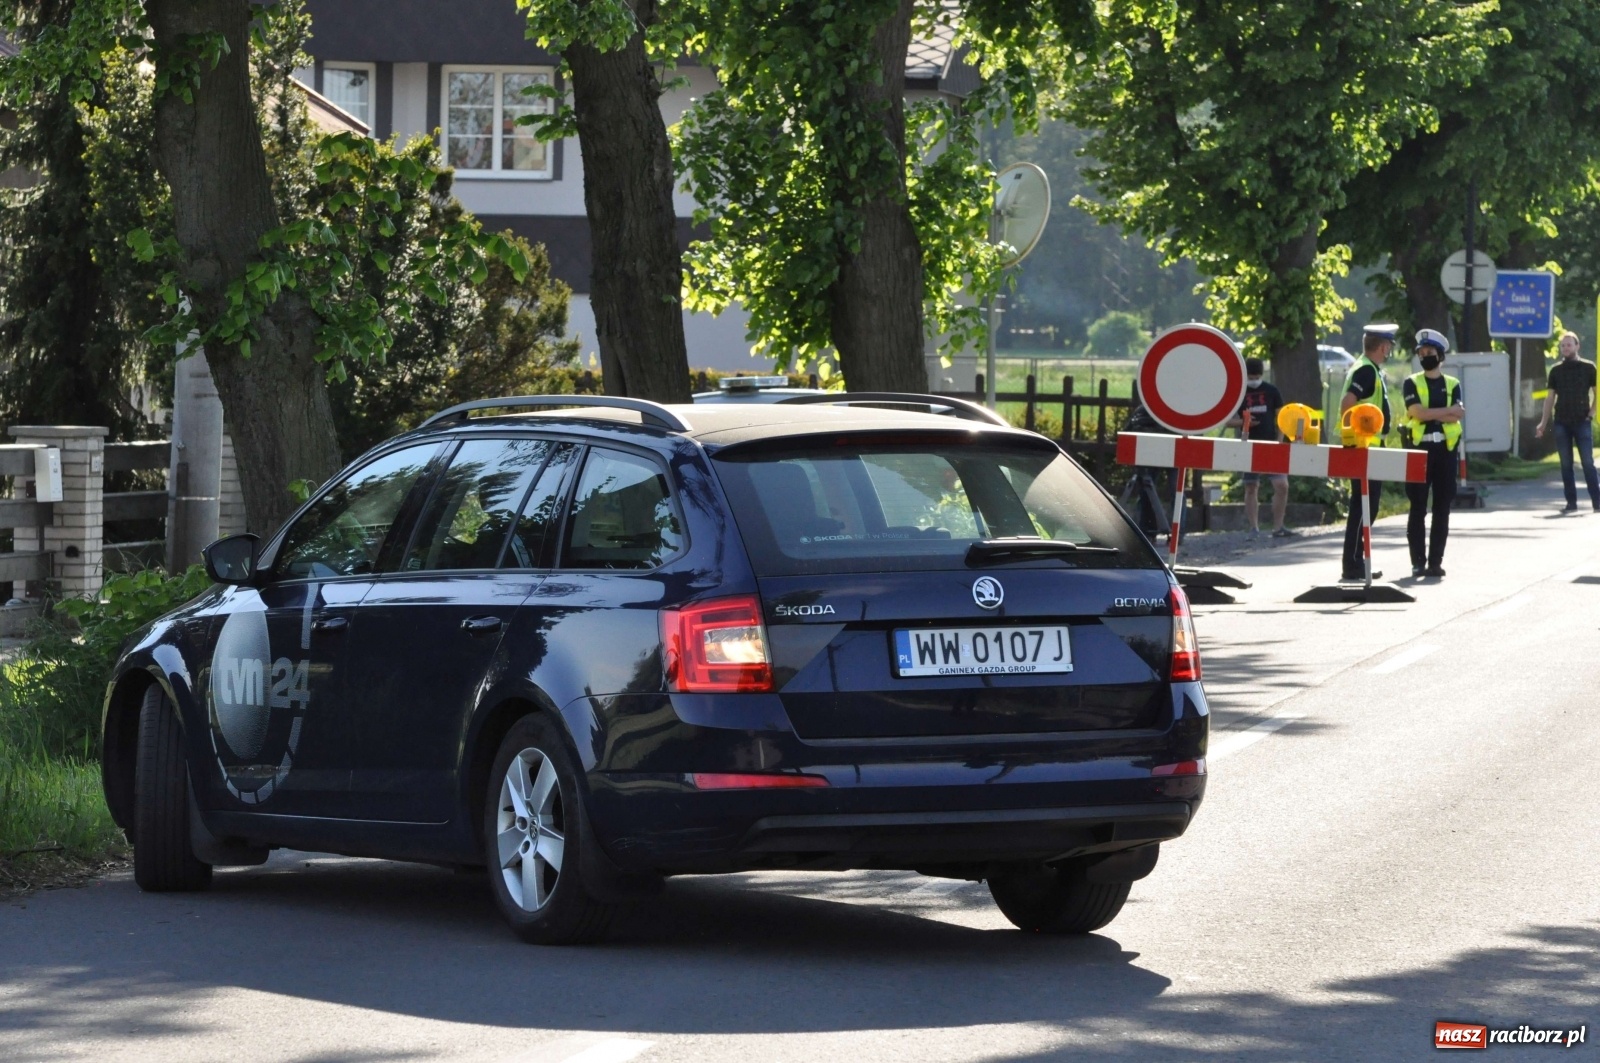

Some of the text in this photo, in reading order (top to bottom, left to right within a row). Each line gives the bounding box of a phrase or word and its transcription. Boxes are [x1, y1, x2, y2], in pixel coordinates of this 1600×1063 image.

[1114, 597, 1167, 608] OCTAVIA
[775, 604, 836, 616] ŠKODA
[915, 633, 961, 665] WW
[900, 654, 910, 664] PL
[938, 665, 1037, 675] GANINEX GAZDA GROUP
